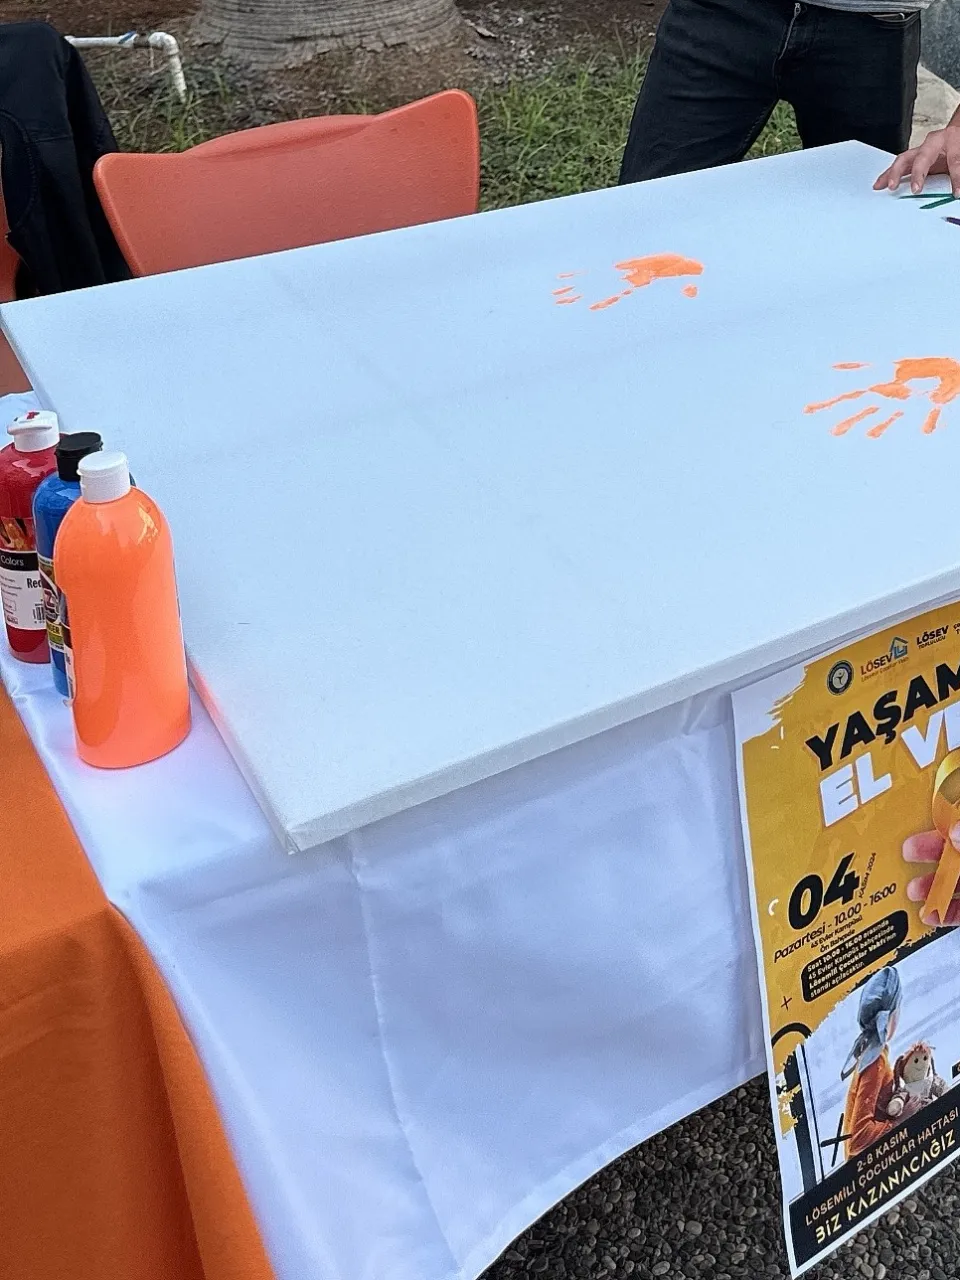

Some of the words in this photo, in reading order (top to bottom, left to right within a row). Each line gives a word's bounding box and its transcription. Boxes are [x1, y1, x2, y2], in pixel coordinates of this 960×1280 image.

[0, 554, 24, 567] Colors
[860, 651, 893, 676] LÖSEV
[916, 624, 949, 645] LÖSEV
[819, 752, 893, 827] EL
[788, 851, 860, 931] 04
[774, 922, 826, 963] Pazartesi
[834, 902, 862, 925] 10.00
[870, 882, 897, 905] 16:00
[839, 950, 867, 972] Çocuklar
[805, 1181, 857, 1226] LÖSEMİLİ
[858, 1139, 916, 1187] ÇOCUKLAR
[917, 1106, 959, 1145] HAFTASI
[857, 1154, 874, 1172] 2-8
[875, 1127, 909, 1157] KASIM
[815, 1212, 842, 1244] BİZ
[846, 1129, 956, 1221] KAZANACAĞIZ
